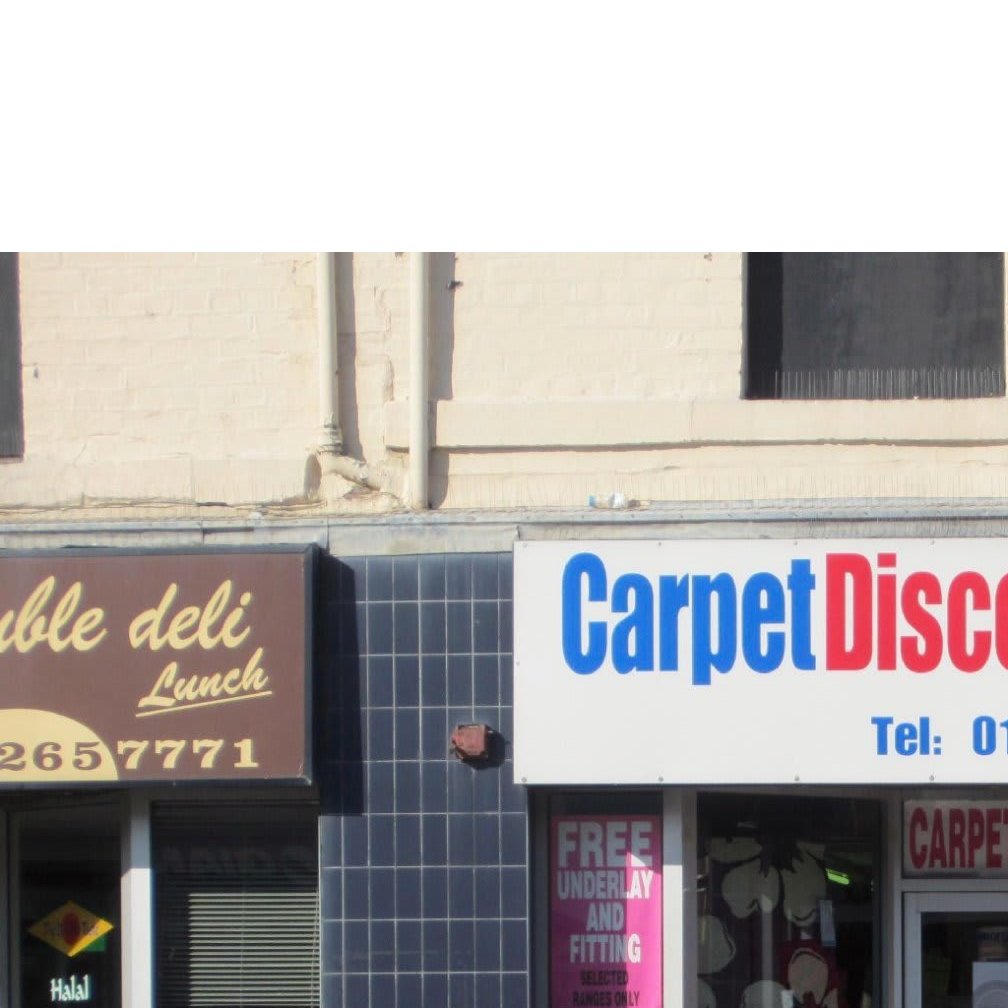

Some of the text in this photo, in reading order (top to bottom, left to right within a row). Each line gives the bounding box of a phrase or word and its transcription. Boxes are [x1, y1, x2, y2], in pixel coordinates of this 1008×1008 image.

[128, 580, 253, 651] deli
[562, 552, 816, 685] Carpet
[138, 648, 269, 708] Lunch
[871, 716, 942, 756] Tel:
[0, 738, 259, 771] 265 7771
[557, 821, 653, 868] FREE
[557, 869, 654, 900] UNDERLAY
[586, 902, 625, 932] AND
[570, 933, 641, 963] FITTING
[50, 974, 89, 1001] Halal
[580, 970, 628, 986] SELECTED
[573, 991, 640, 1007] RANGES ONLY
